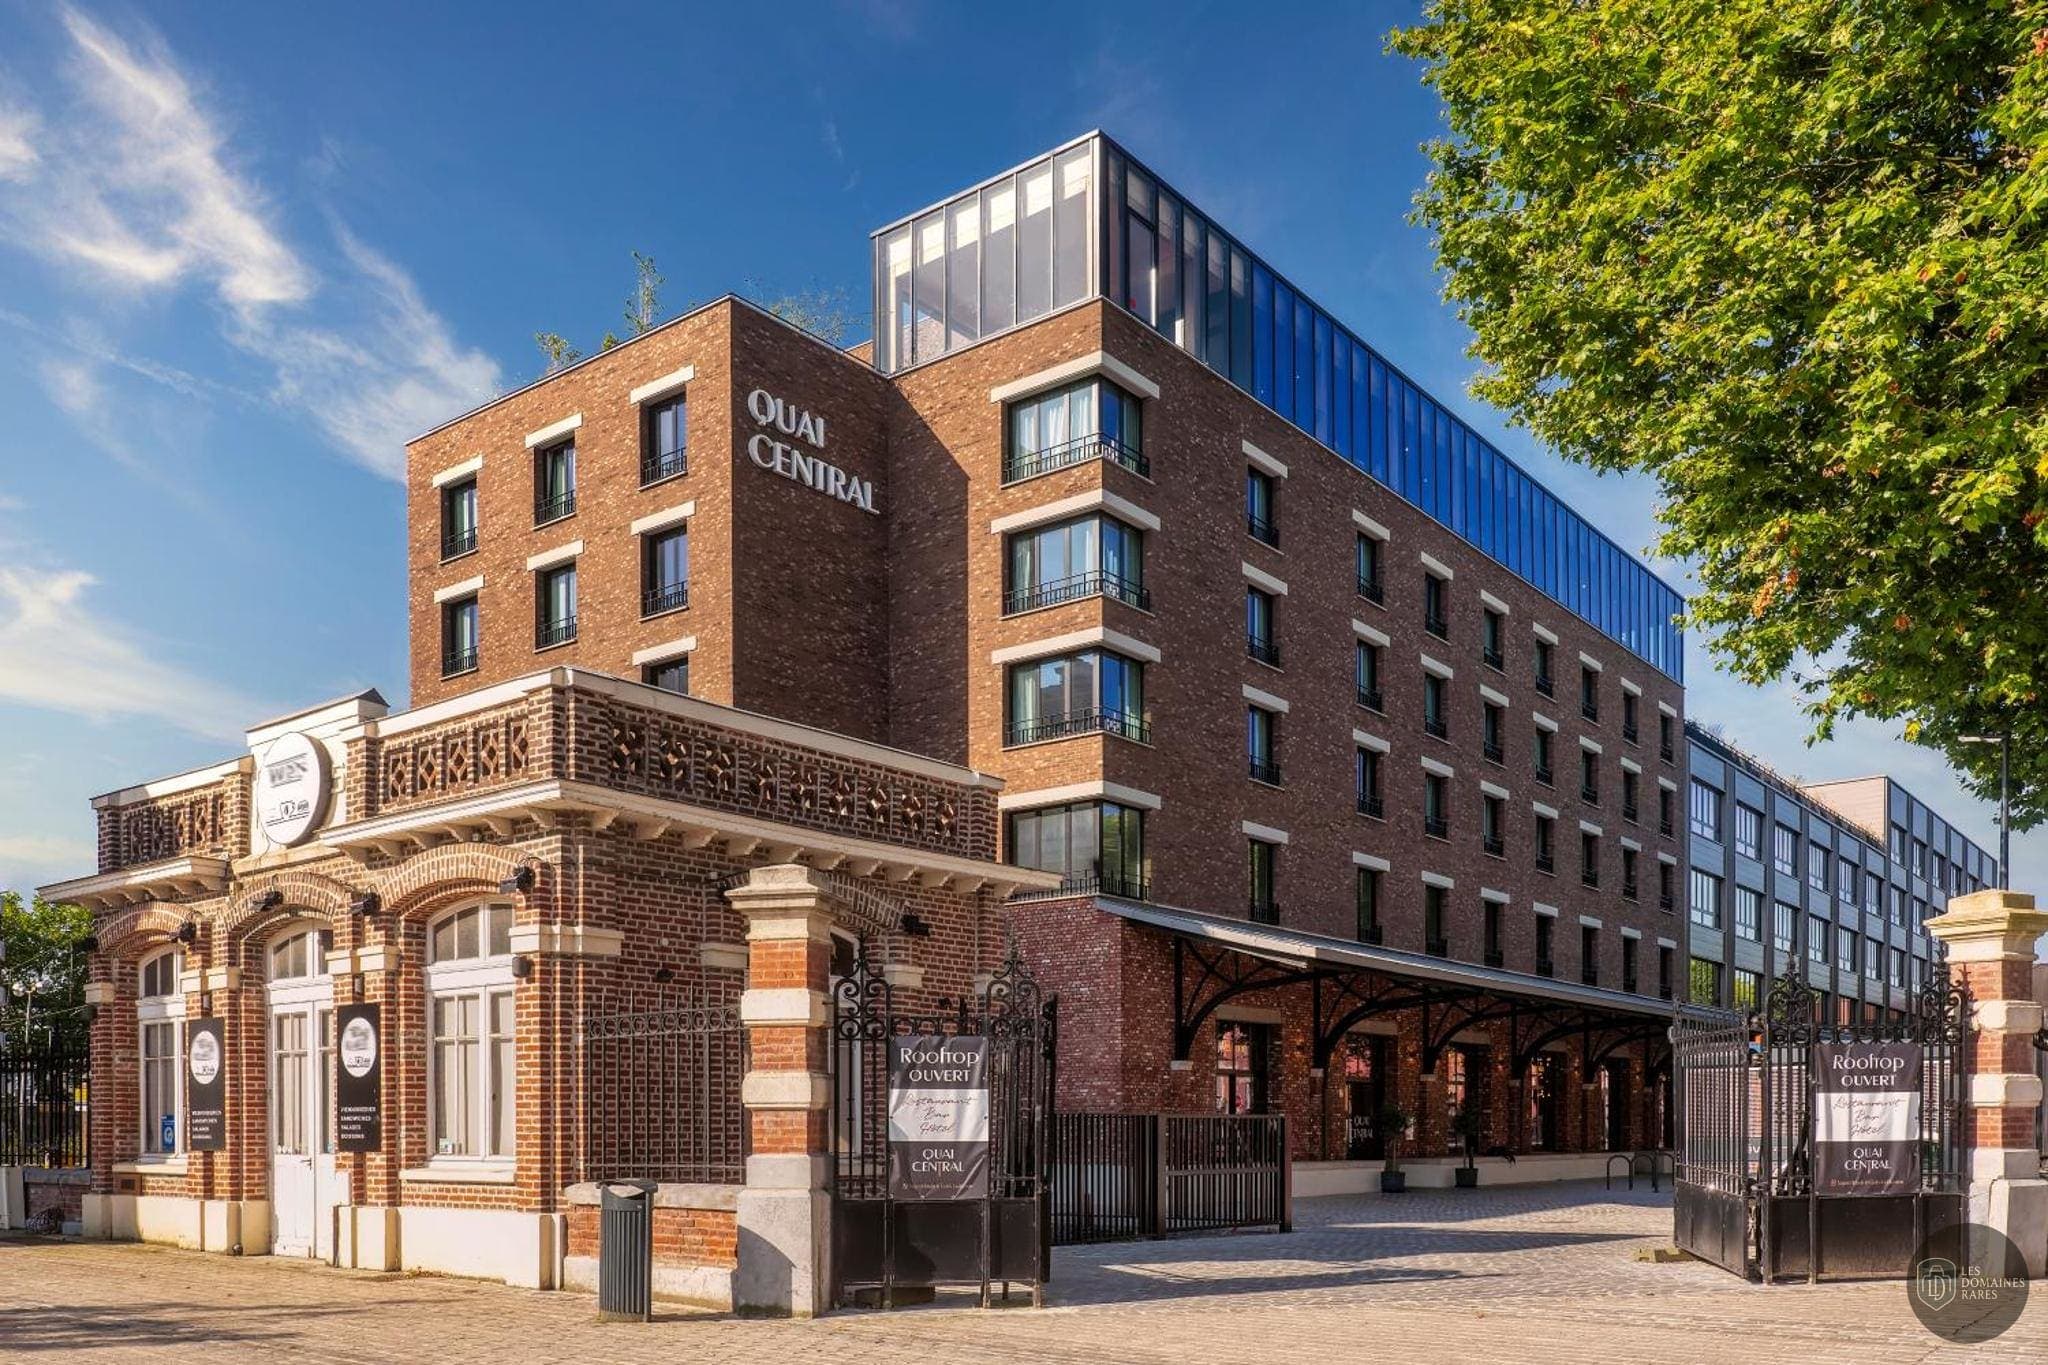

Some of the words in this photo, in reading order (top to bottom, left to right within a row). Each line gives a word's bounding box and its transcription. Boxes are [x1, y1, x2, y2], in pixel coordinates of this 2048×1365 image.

[747, 389, 825, 448] QUAI
[747, 433, 880, 514] CENTRAL
[900, 1046, 979, 1068] Rooftop
[1833, 1053, 1904, 1072] Rooftop
[908, 1069, 971, 1082] OUVERT
[1841, 1074, 1897, 1087] OUVERT
[922, 1148, 954, 1160] QUAI
[1853, 1148, 1882, 1159] QUAI
[911, 1161, 966, 1177] CENTRAL
[1844, 1159, 1892, 1174] CENTRAL
